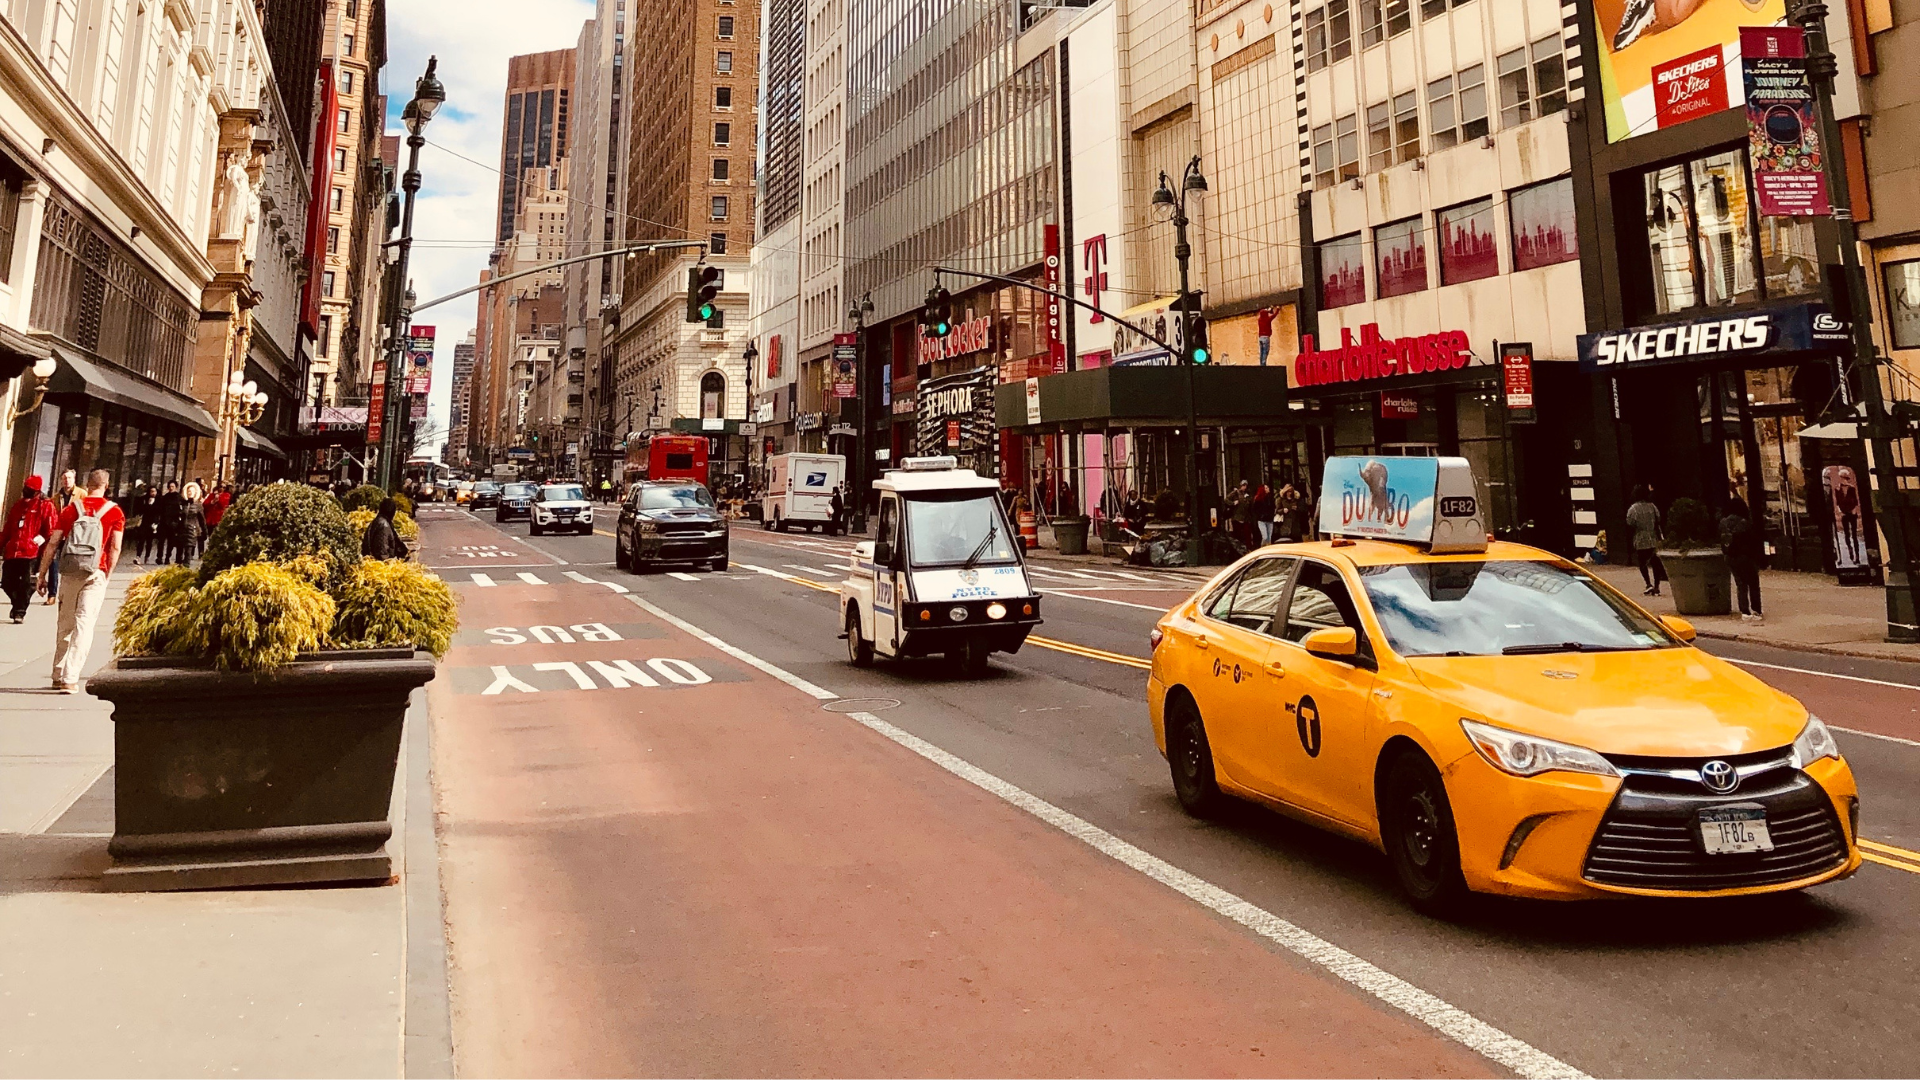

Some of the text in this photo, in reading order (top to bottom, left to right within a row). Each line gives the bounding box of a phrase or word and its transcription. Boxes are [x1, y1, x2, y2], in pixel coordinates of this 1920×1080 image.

[1657, 54, 1718, 85] SKECHERS
[1754, 76, 1800, 87] JOURNEY
[1676, 97, 1711, 115] ORIGINAL
[1049, 269, 1058, 339] target
[1596, 315, 1769, 366] SKECHERS
[926, 386, 973, 419] SEPHORA
[1384, 397, 1418, 414] charlotte russe
[1611, 377, 1621, 419] SKECHERS
[1443, 500, 1474, 513] 1F82
[876, 581, 892, 605] NYPD
[951, 590, 998, 599] POLICE
[483, 622, 625, 646] BUS
[480, 657, 714, 696] ONLY
